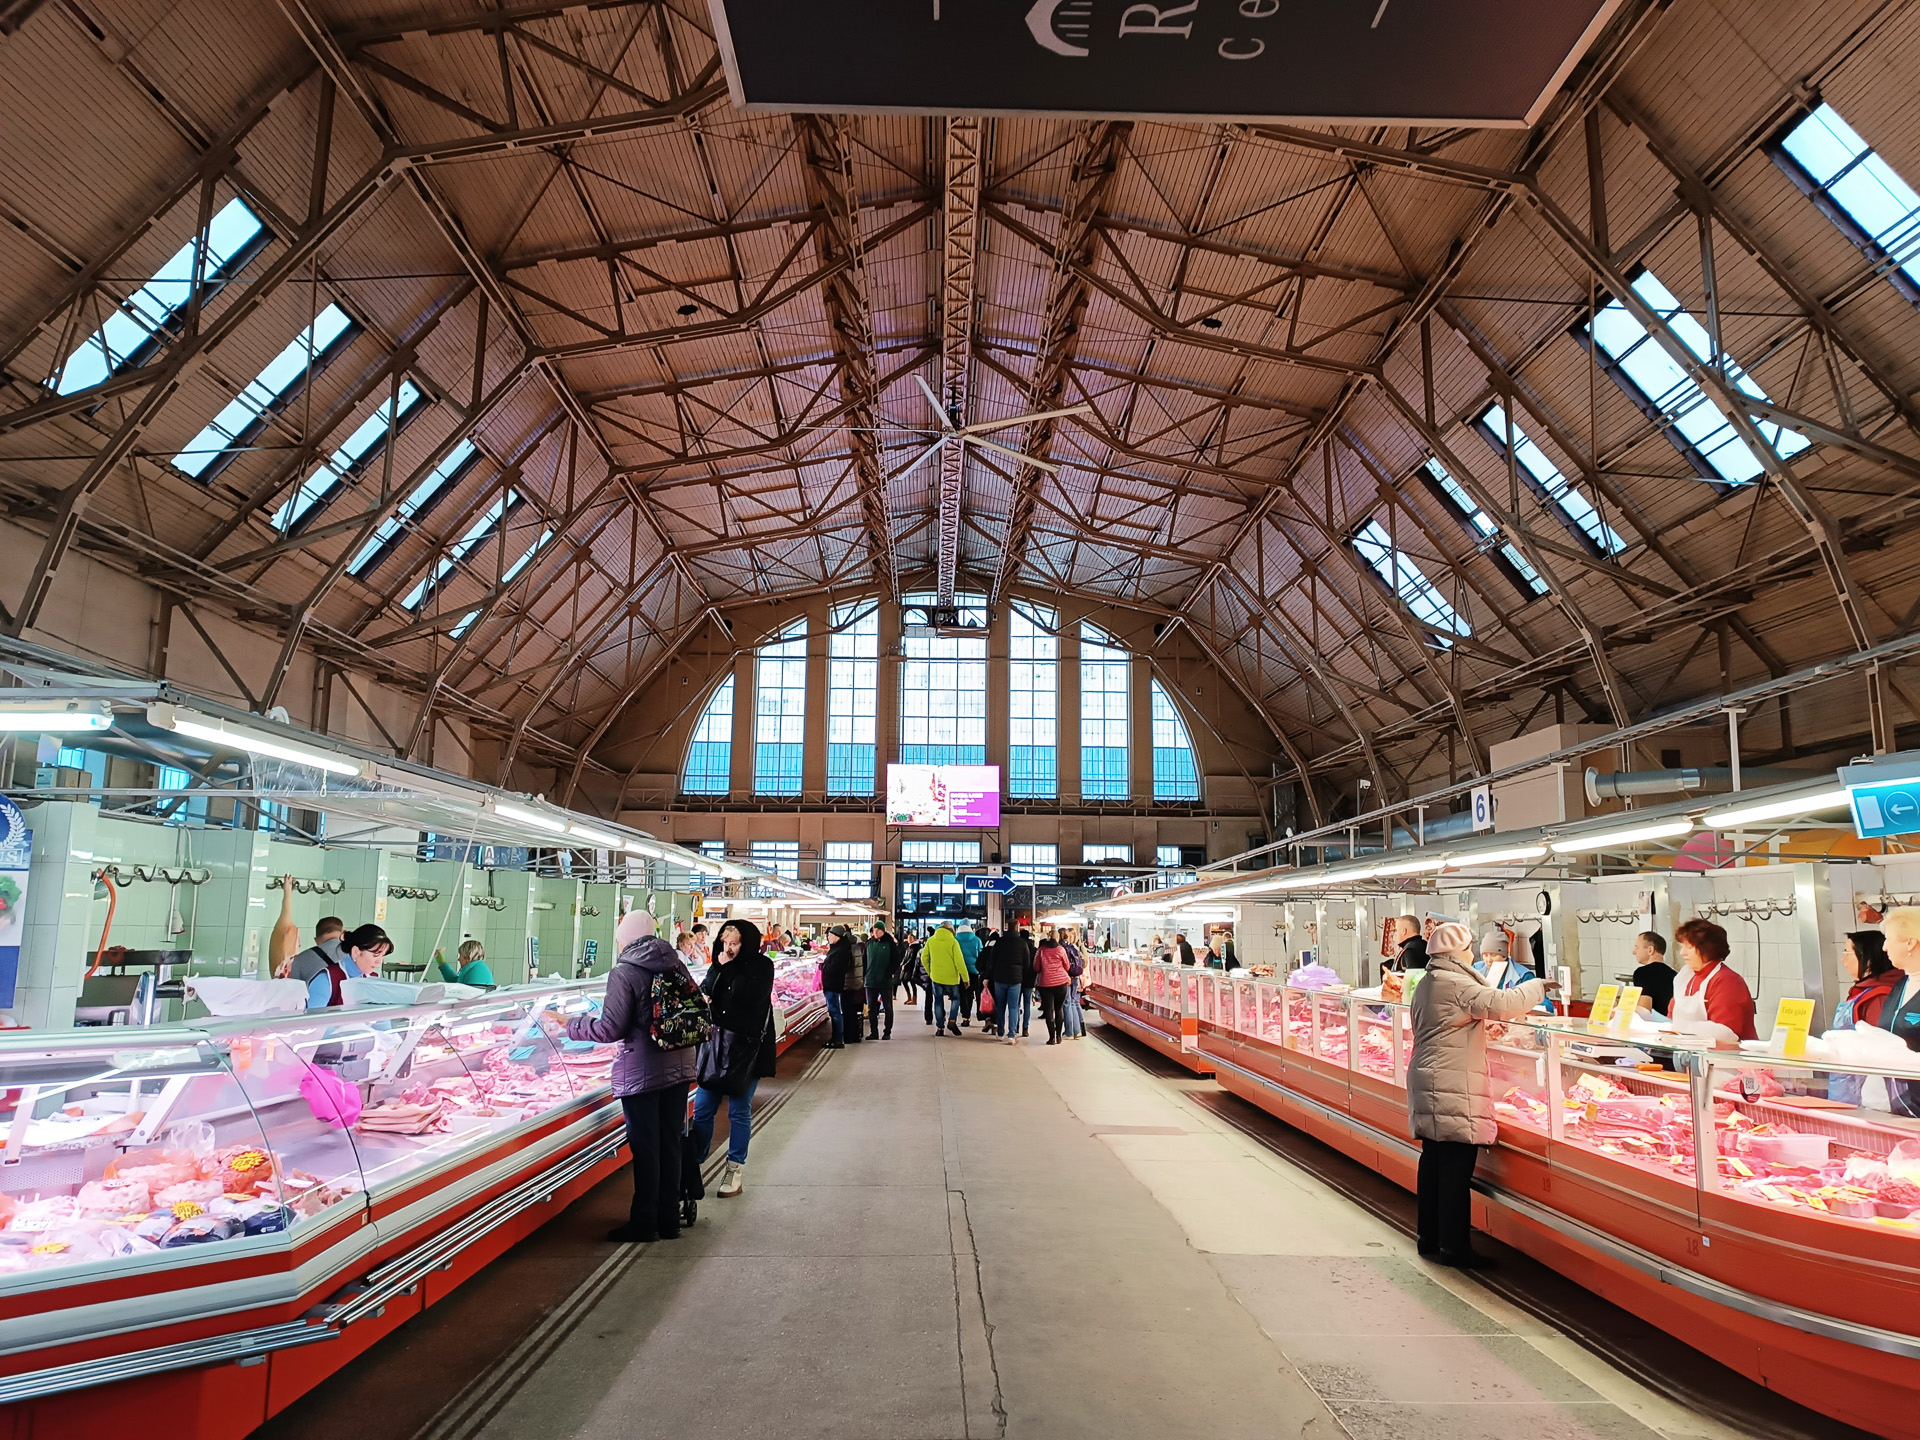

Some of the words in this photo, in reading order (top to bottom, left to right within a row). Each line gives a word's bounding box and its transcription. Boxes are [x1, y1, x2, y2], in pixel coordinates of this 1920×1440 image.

[1476, 794, 1485, 823] 6
[978, 879, 994, 889] WC
[1686, 1236, 1700, 1257] 18
